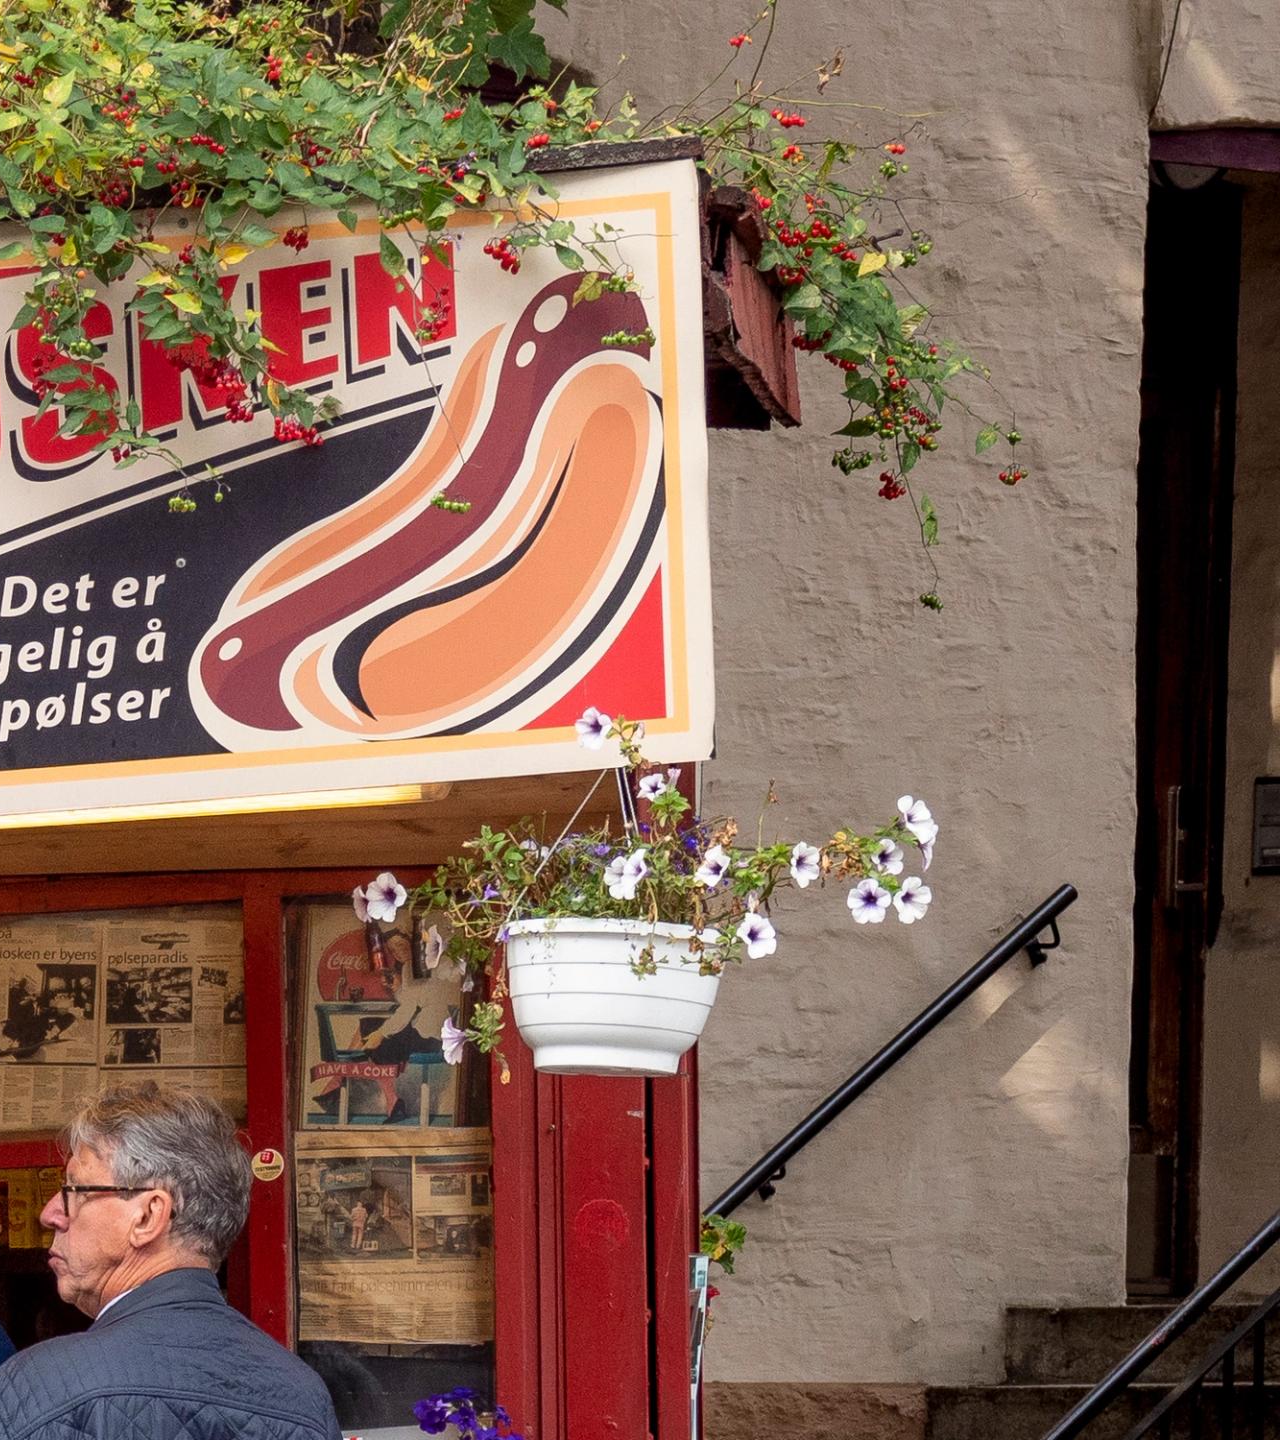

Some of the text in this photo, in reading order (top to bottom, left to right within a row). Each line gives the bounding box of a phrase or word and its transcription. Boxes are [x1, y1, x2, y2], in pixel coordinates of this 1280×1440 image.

[0, 573, 96, 617] Det
[112, 574, 166, 607] er
[136, 618, 167, 663] å
[43, 949, 57, 961] er
[59, 947, 98, 965] byens
[107, 949, 189, 968] pølseparadis
[351, 1064, 361, 1075] A
[363, 1066, 396, 1077] COKE
